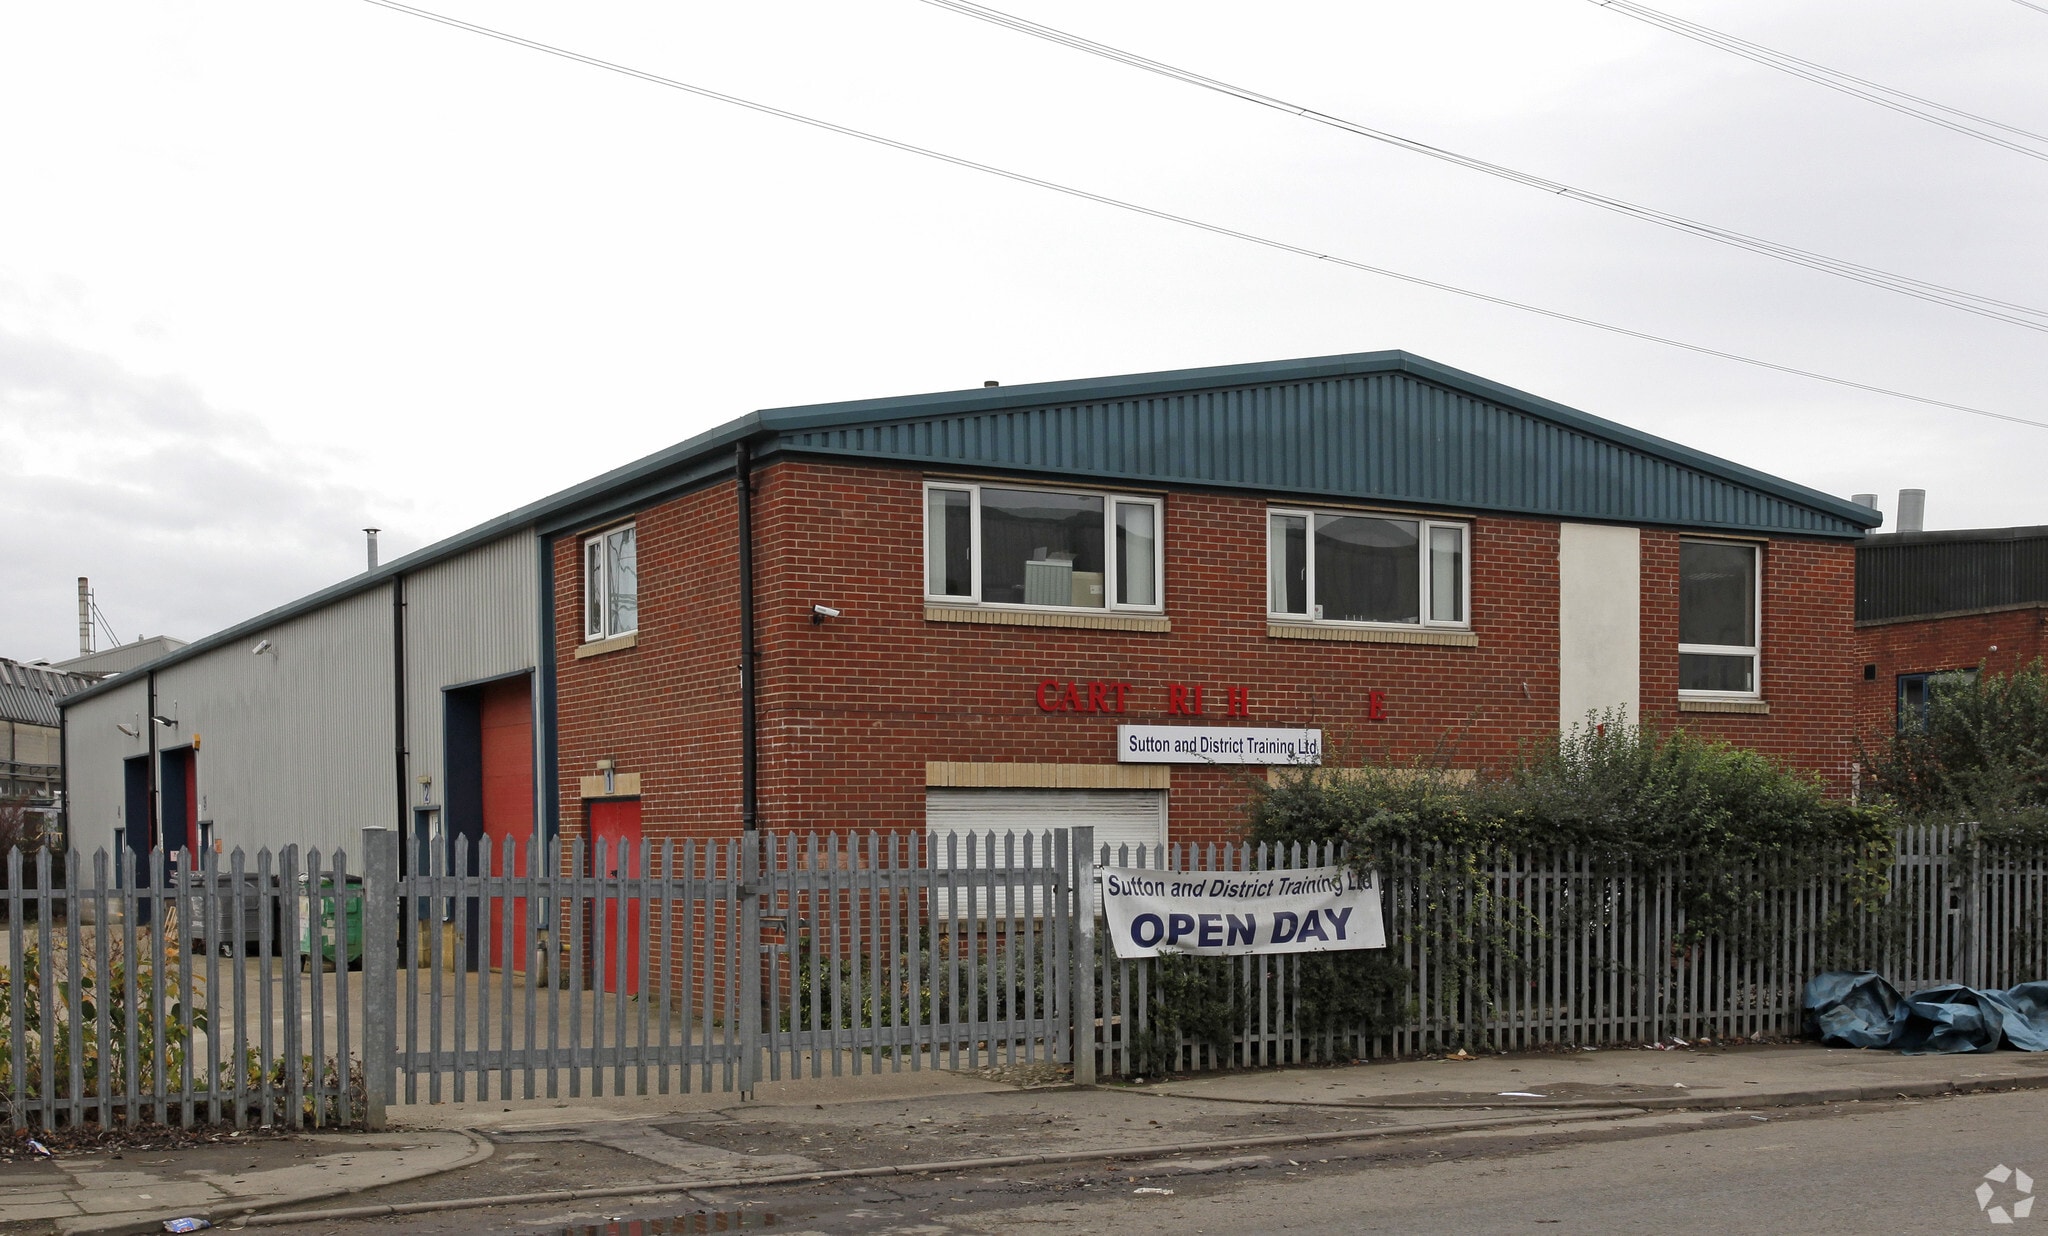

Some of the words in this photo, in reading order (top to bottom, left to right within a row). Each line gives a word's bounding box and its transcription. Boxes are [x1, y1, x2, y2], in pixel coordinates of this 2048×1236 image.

[1036, 679, 1133, 714] CART
[1368, 690, 1387, 720] E
[1128, 734, 1170, 753] Sutton
[1174, 736, 1197, 753] and
[1200, 736, 1244, 754] District
[1247, 737, 1294, 758] Training
[1298, 738, 1317, 755] Ltd
[1108, 874, 1165, 897] Sutton
[1171, 878, 1207, 898] and
[1209, 878, 1274, 898] District
[1278, 874, 1344, 898] Training
[1130, 912, 1257, 949] OPEN
[1270, 906, 1354, 944] DAY
